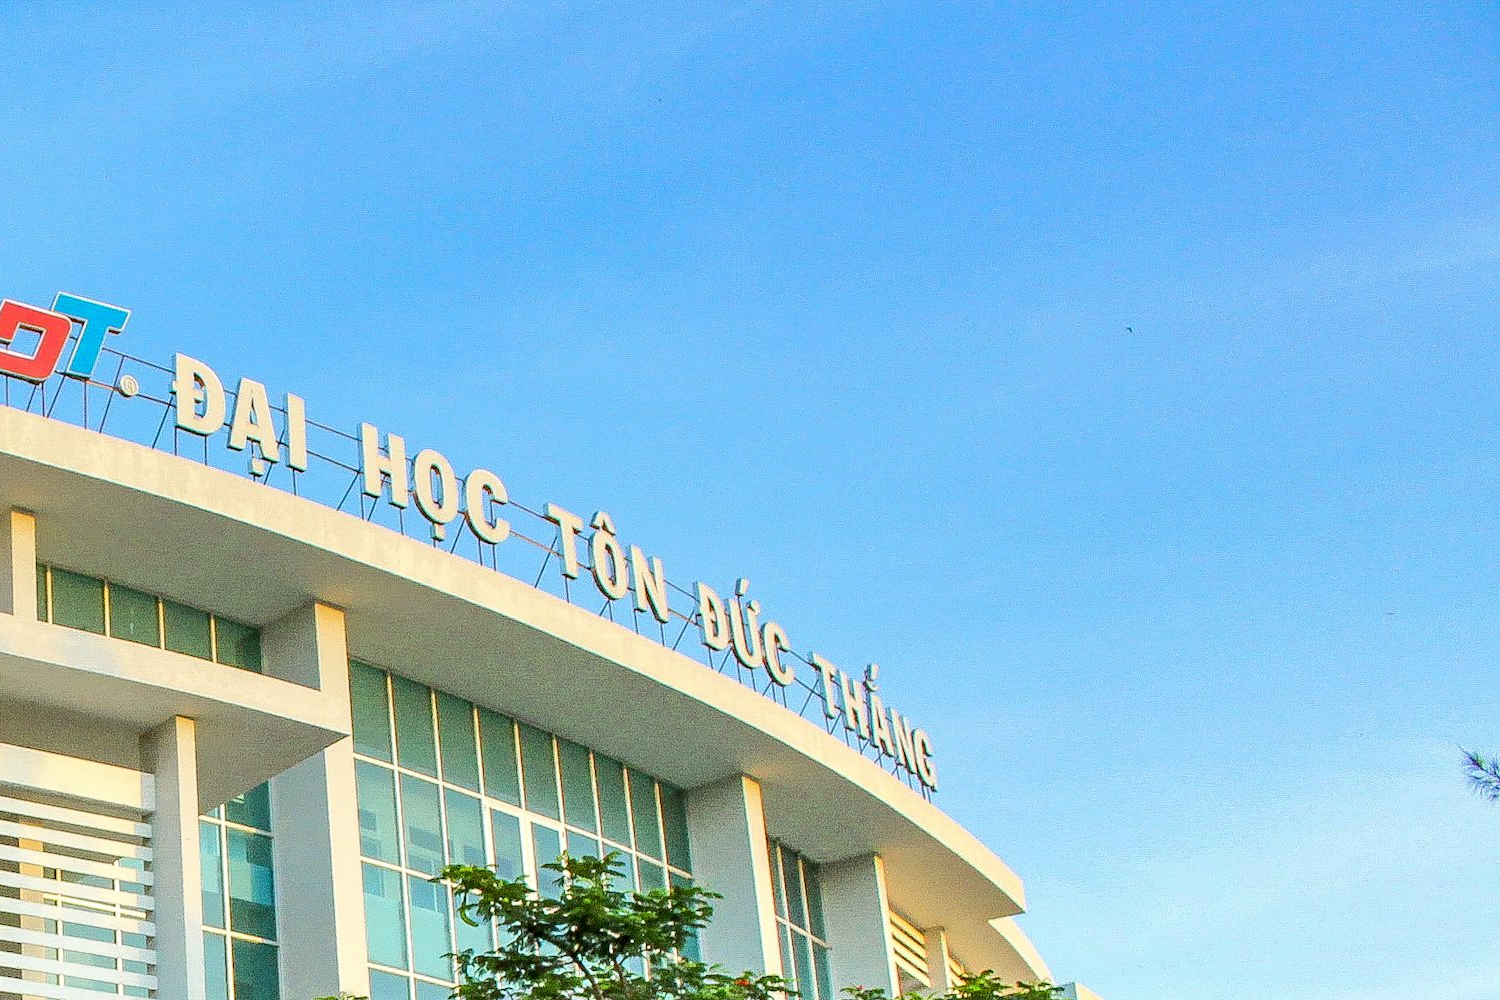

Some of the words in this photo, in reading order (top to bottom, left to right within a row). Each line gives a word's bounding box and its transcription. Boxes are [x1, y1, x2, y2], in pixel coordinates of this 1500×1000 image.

[172, 352, 307, 476] ĐẠI
[359, 422, 510, 544] HỌC
[543, 502, 669, 624] TÔN
[693, 577, 796, 687] ĐỨC
[808, 662, 939, 793] THẮNG
